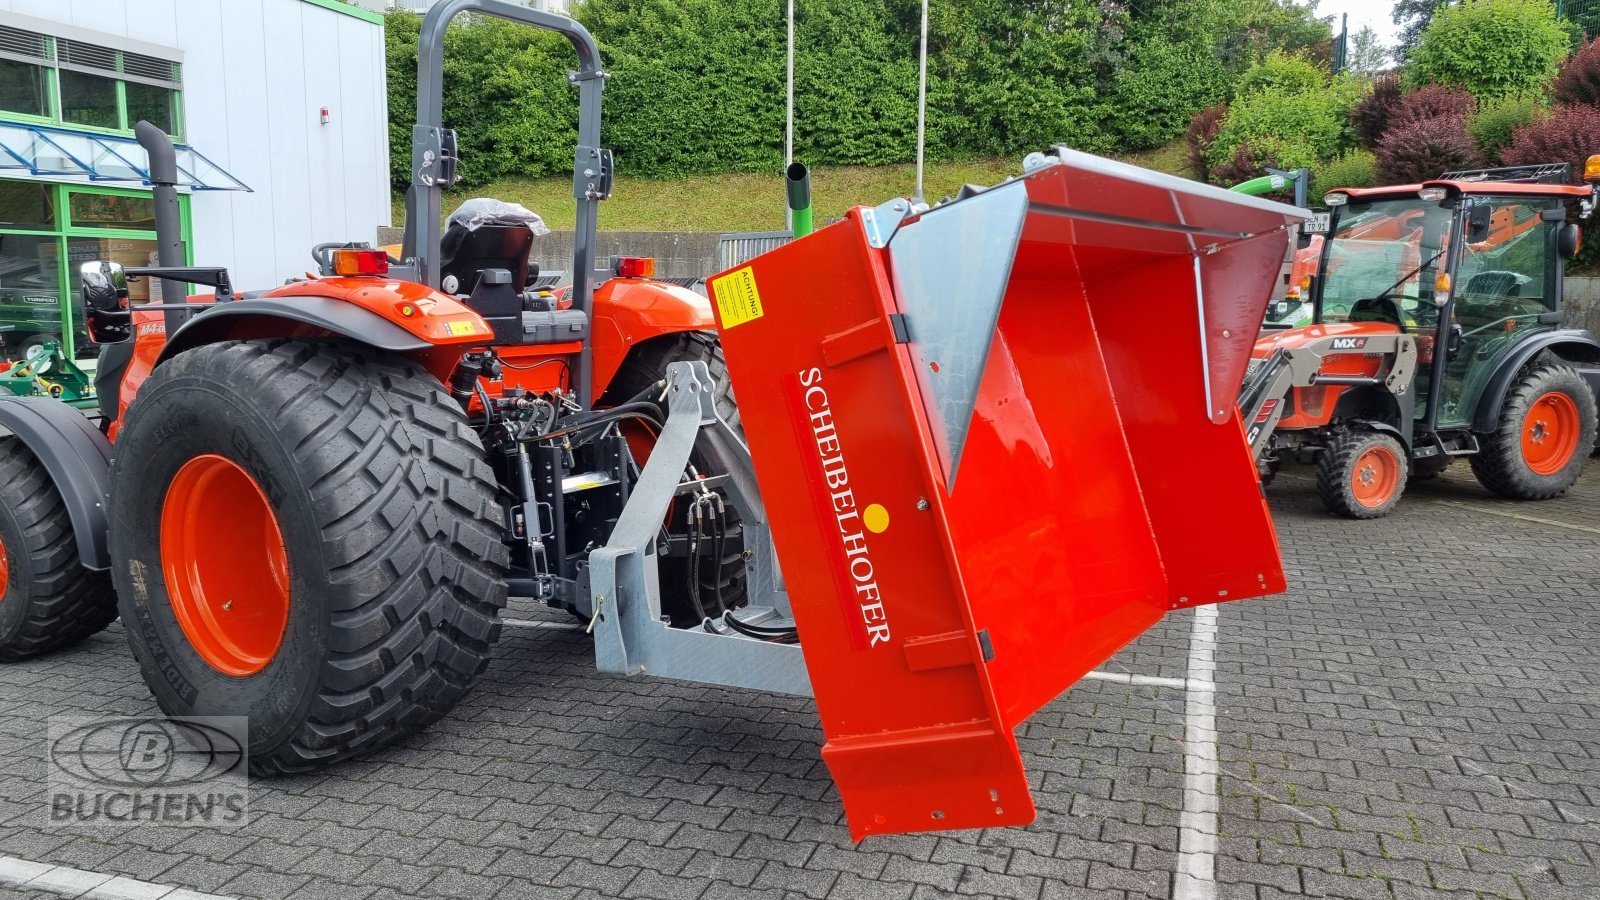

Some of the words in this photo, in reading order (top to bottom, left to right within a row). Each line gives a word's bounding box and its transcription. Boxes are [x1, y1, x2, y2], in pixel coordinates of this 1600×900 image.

[741, 270, 759, 317] ACHTUNG!
[1333, 338, 1356, 348] MX
[798, 366, 891, 649] SCHEIBELHOFER
